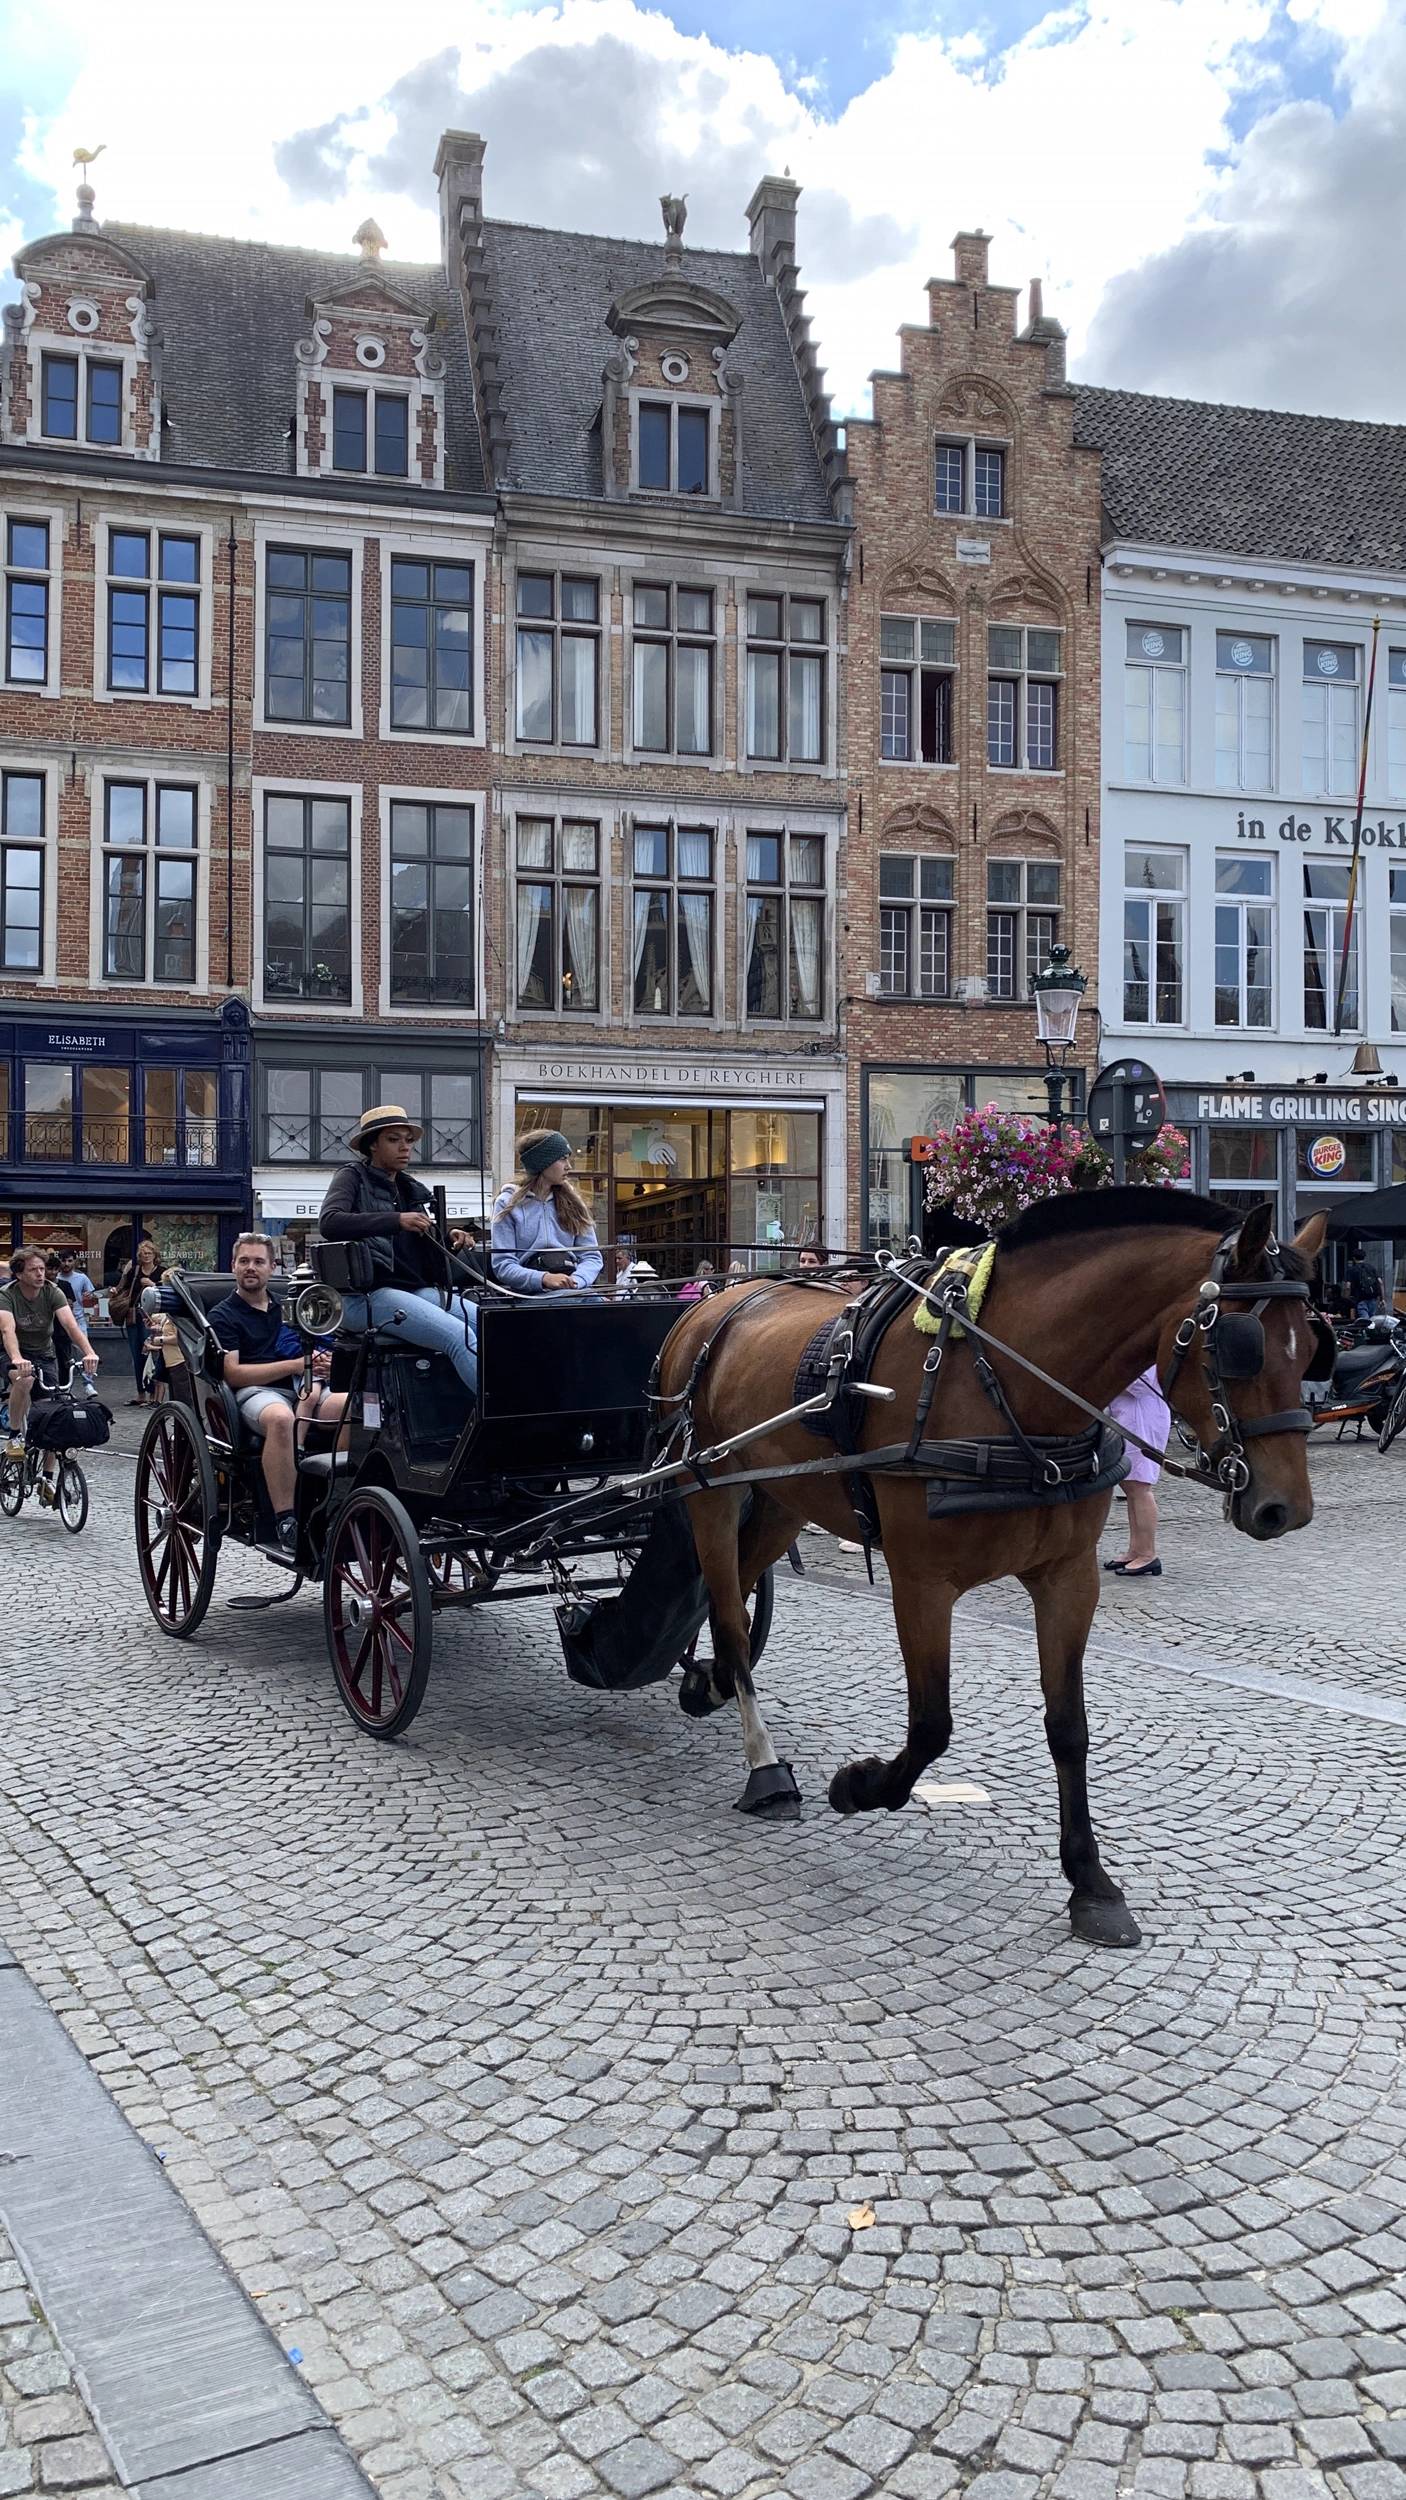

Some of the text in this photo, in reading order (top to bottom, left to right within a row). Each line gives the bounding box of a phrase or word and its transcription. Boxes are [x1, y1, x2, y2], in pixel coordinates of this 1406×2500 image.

[1237, 811, 1266, 839] in
[1279, 815, 1311, 842] de
[538, 1063, 807, 1085] BOEKHANDEL DE REYGHERE
[1198, 1095, 1262, 1119] FLAME
[1270, 1096, 1360, 1121] GRILLING
[1313, 1143, 1342, 1157] BURGER
[1313, 1150, 1342, 1167] KING
